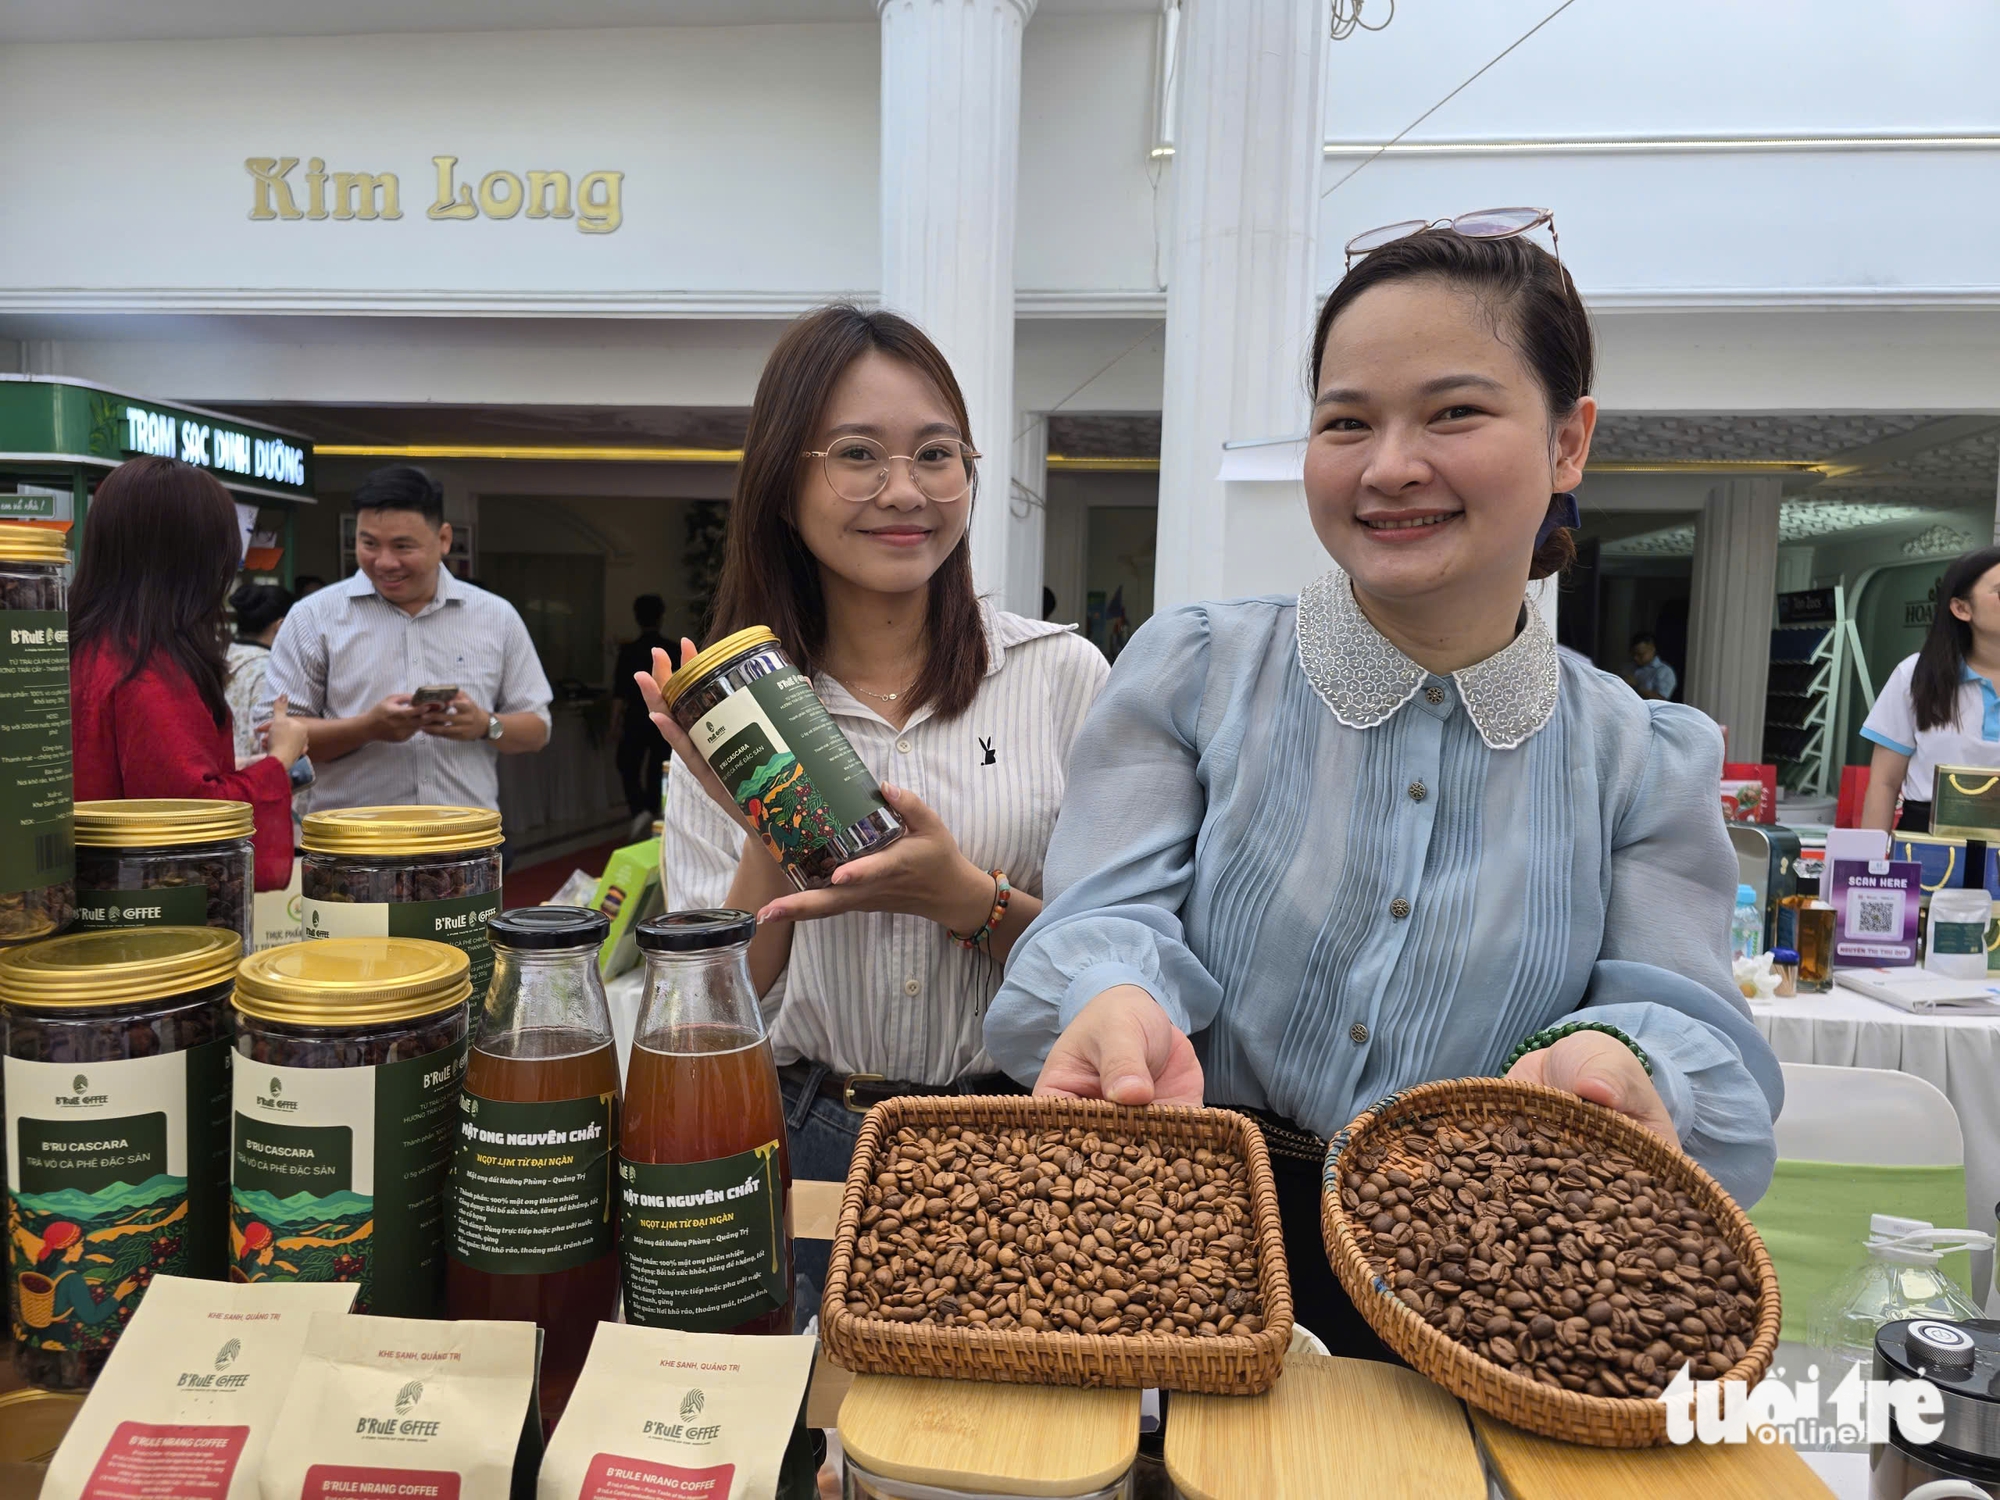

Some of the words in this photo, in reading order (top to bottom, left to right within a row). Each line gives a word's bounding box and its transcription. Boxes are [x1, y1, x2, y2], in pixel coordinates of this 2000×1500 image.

[243, 156, 404, 221] Kim
[426, 155, 625, 234] Long
[181, 420, 210, 467] SẠC
[213, 428, 250, 475] DINH
[254, 437, 304, 486] DƯỠNG
[1848, 876, 1877, 887] SCAN
[1879, 878, 1908, 889] HERE
[461, 1122, 479, 1141] MẬT
[479, 1129, 505, 1145] ONG
[506, 1129, 567, 1146] NGUYÊN
[569, 1121, 602, 1142] CHẤT
[68, 1139, 129, 1152] CASCARA
[265, 1144, 315, 1158] CASCARA
[59, 1158, 74, 1169] CÀ
[76, 1157, 98, 1169] PHÊ
[100, 1155, 125, 1168] ĐẶC
[127, 1151, 151, 1164] SẢN
[257, 1159, 269, 1171] CÀ
[270, 1162, 288, 1174] PHÊ
[289, 1164, 311, 1176] ĐẶC
[313, 1164, 336, 1175] SẢN
[476, 1153, 498, 1166] NGỌT
[497, 1157, 516, 1168] LỊM
[531, 1158, 547, 1169] ĐẠI
[548, 1154, 574, 1166] NGÀN
[623, 1188, 639, 1207] MẬT
[640, 1194, 665, 1208] ONG
[666, 1189, 725, 1208] NGUYÊN
[726, 1175, 760, 1200] CHẤT
[539, 1196, 558, 1204] thiên
[551, 1225, 565, 1234] pha
[640, 1219, 660, 1230] NGỌT
[660, 1220, 678, 1231] LỊM
[692, 1218, 708, 1229] ĐẠI
[709, 1212, 734, 1225] NGÀN
[520, 1246, 546, 1255] thoáng
[722, 1281, 736, 1290] pha
[378, 1350, 394, 1358] KHE
[395, 1351, 419, 1361] SANH,
[421, 1351, 448, 1361] QUẢNG
[449, 1352, 462, 1361] TRỊ
[660, 1359, 676, 1367] KHE
[676, 1361, 699, 1370] SANH,
[700, 1362, 727, 1371] QUẢNG
[728, 1364, 740, 1372] TRỊ
[399, 1419, 441, 1436] COFFEE
[685, 1424, 722, 1440] COFFEE
[193, 1438, 230, 1448] COFFEE
[606, 1467, 642, 1481] B'RULE
[642, 1473, 679, 1488] NRANG
[680, 1479, 716, 1491] COFFEE
[322, 1480, 359, 1492] B'RULE
[359, 1483, 397, 1494] NRANG
[398, 1484, 439, 1497] COFFEE
